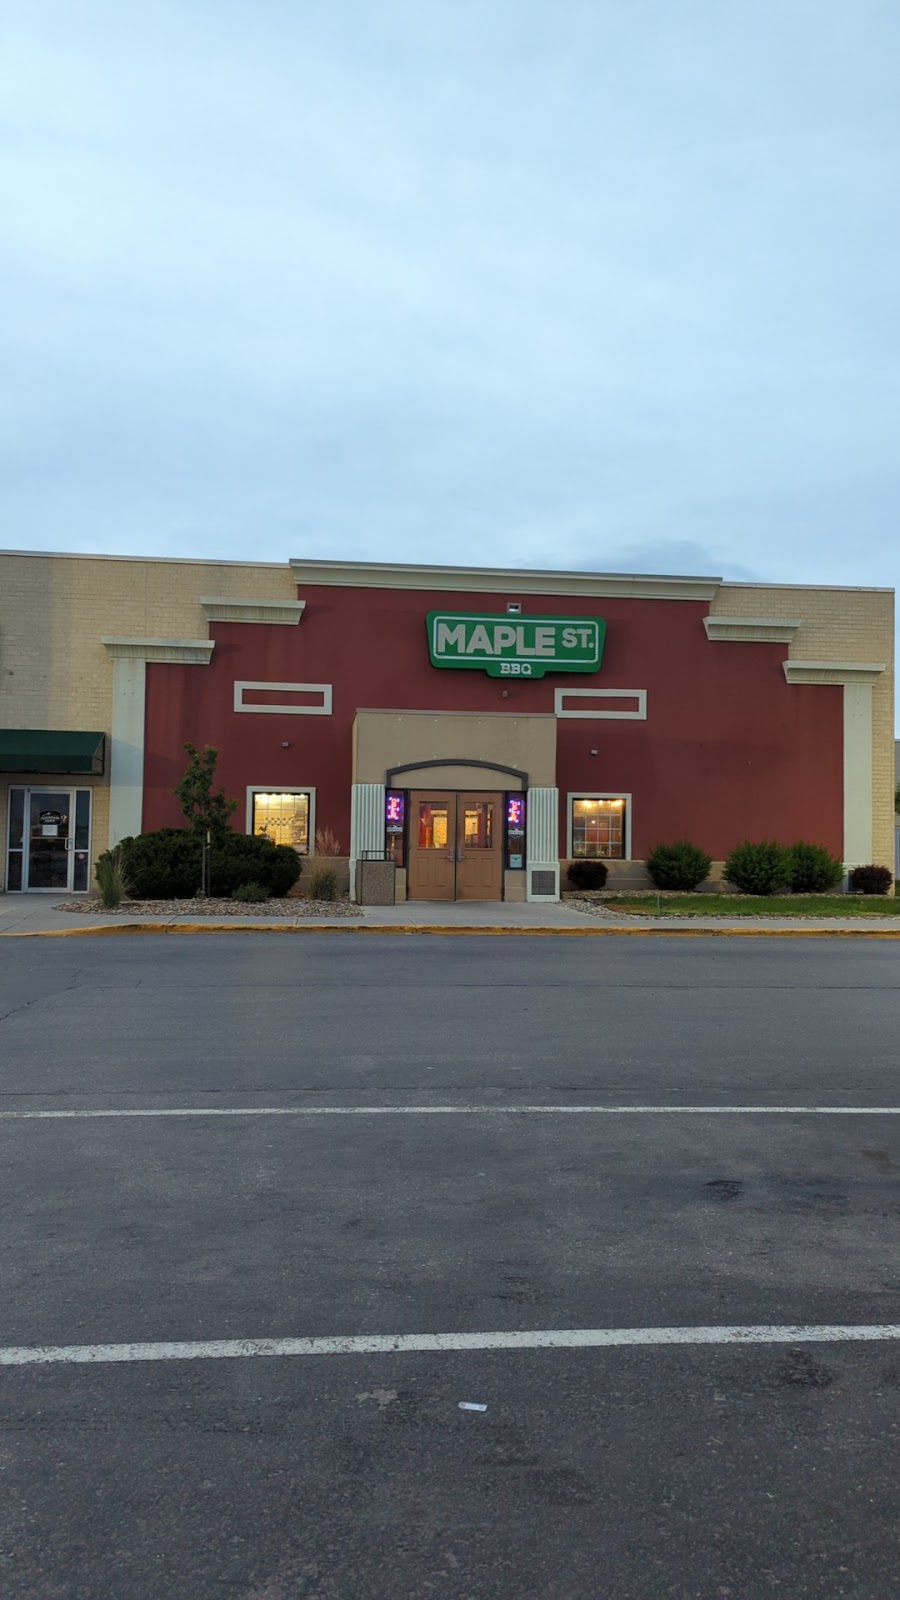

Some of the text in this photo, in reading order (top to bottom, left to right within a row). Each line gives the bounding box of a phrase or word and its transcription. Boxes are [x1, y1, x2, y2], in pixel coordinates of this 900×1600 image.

[437, 623, 594, 656] MAPLE ST.
[500, 663, 532, 675] BBQ
